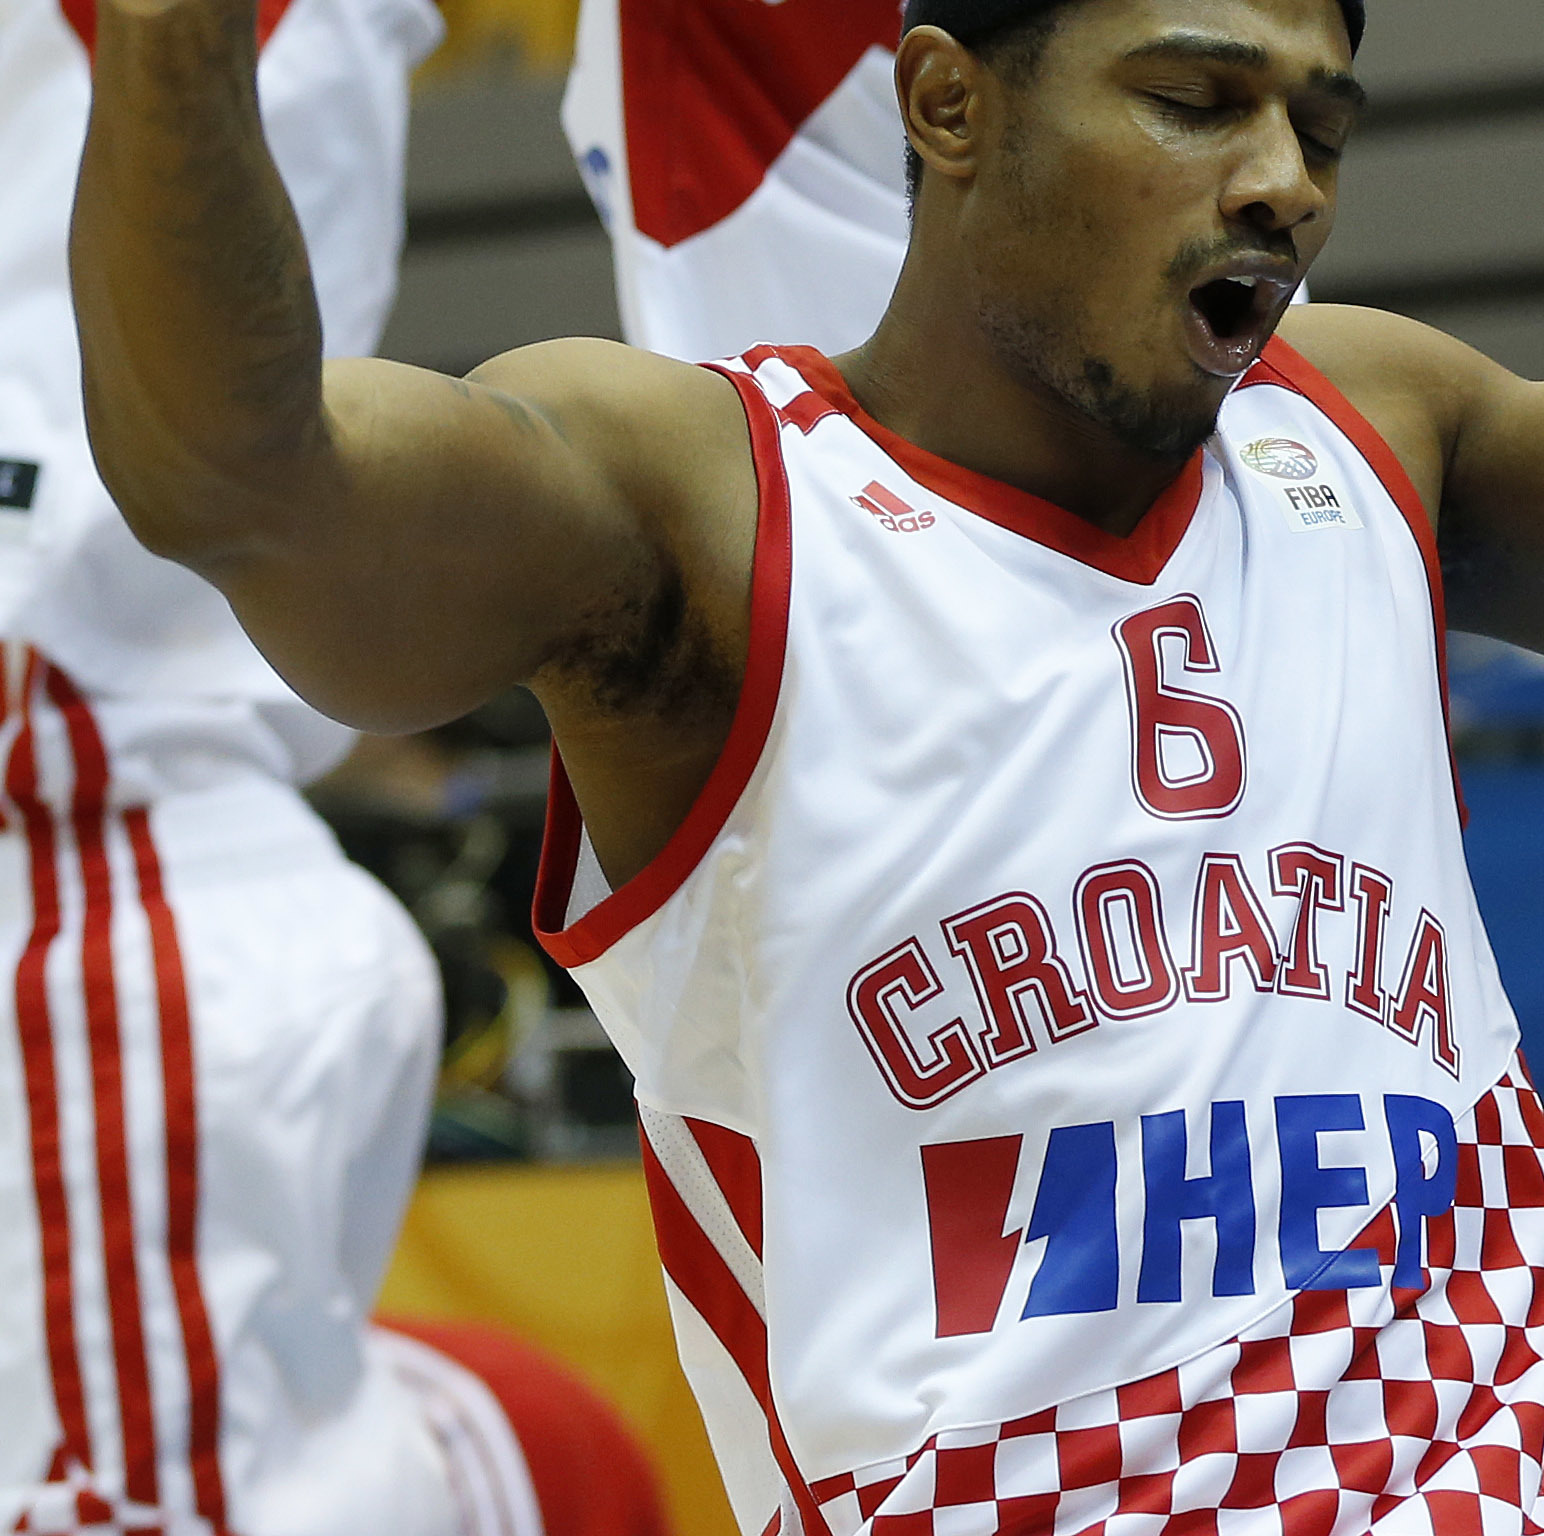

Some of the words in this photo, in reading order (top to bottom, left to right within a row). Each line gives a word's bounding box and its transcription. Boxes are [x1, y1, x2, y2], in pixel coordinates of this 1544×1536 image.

[1284, 484, 1341, 511] FIBA
[1300, 509, 1346, 526] EUROPE
[1111, 591, 1248, 821] 6
[845, 841, 1461, 1112] CROATIA
[1135, 1092, 1459, 1306] HEP
